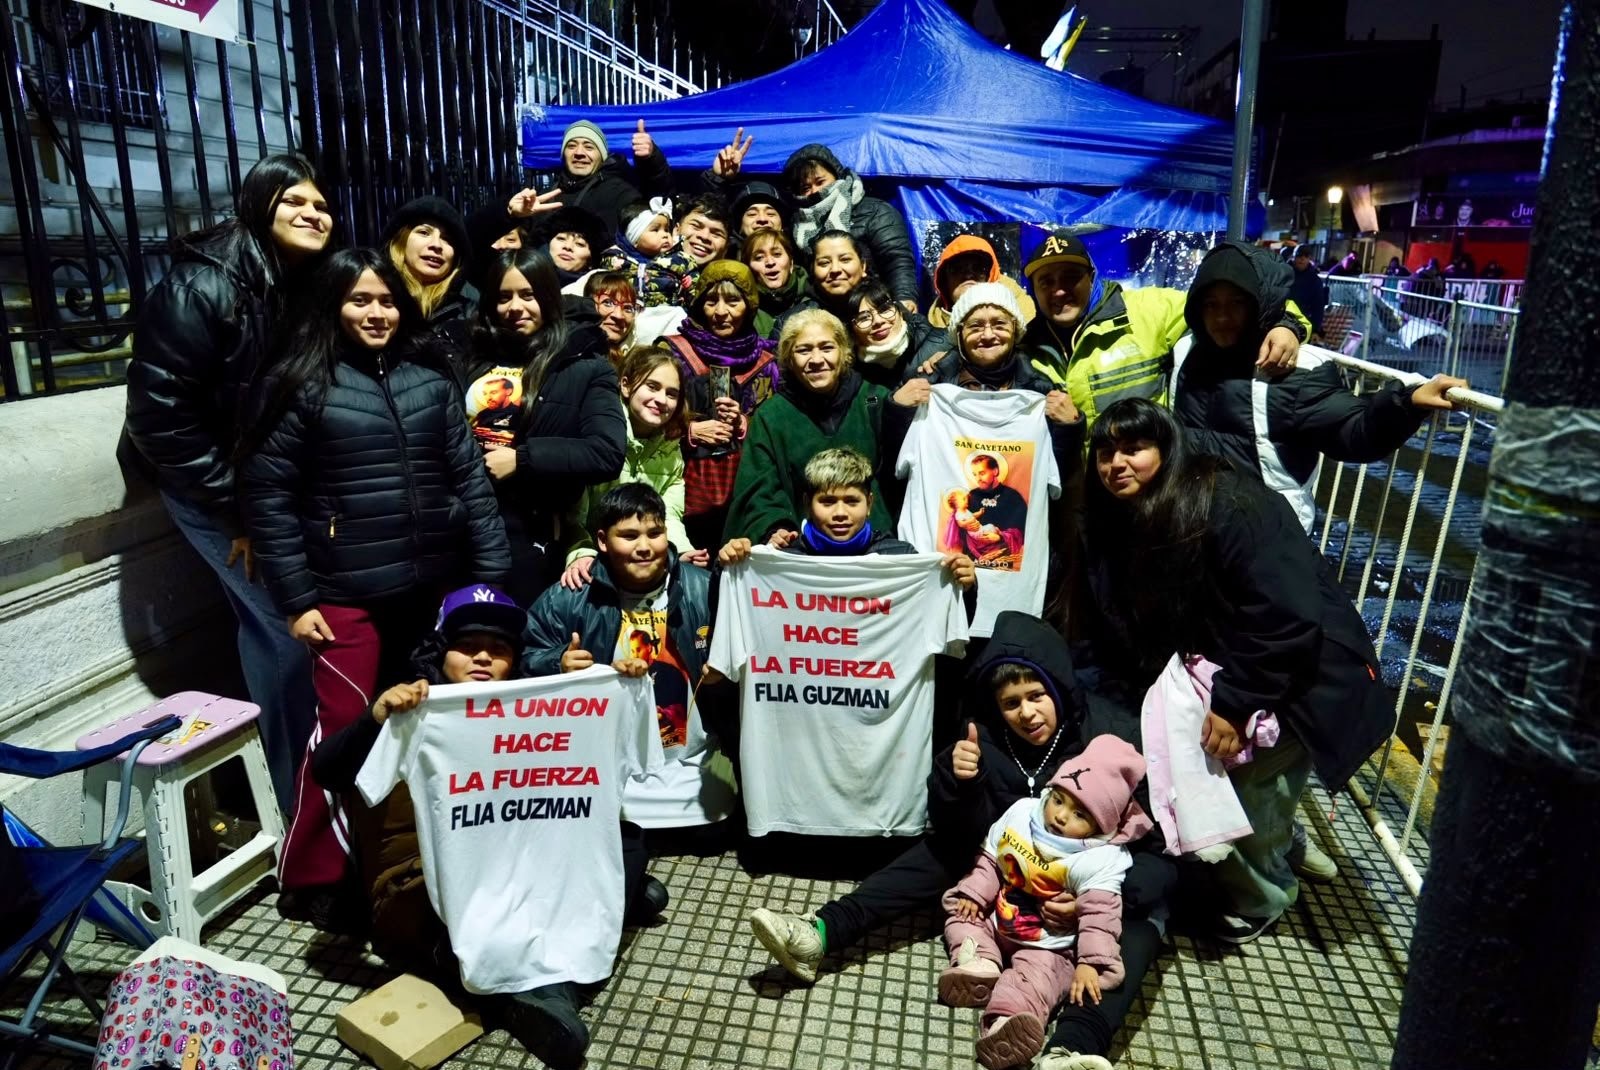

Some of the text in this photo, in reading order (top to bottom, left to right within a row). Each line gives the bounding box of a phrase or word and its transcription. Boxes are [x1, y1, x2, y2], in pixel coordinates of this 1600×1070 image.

[1041, 236, 1069, 257] A's
[954, 440, 1022, 452] SAN CAYETANO
[751, 588, 891, 615] LA UNION
[783, 624, 859, 646] HACE
[750, 656, 896, 679] LA FUERZA
[754, 683, 890, 709] FLIA GUZMAN
[465, 697, 609, 718] LA UNION
[492, 732, 572, 754] HACE
[448, 766, 600, 795] LA FUERZA
[450, 796, 592, 830] FLIA GUZMAN
